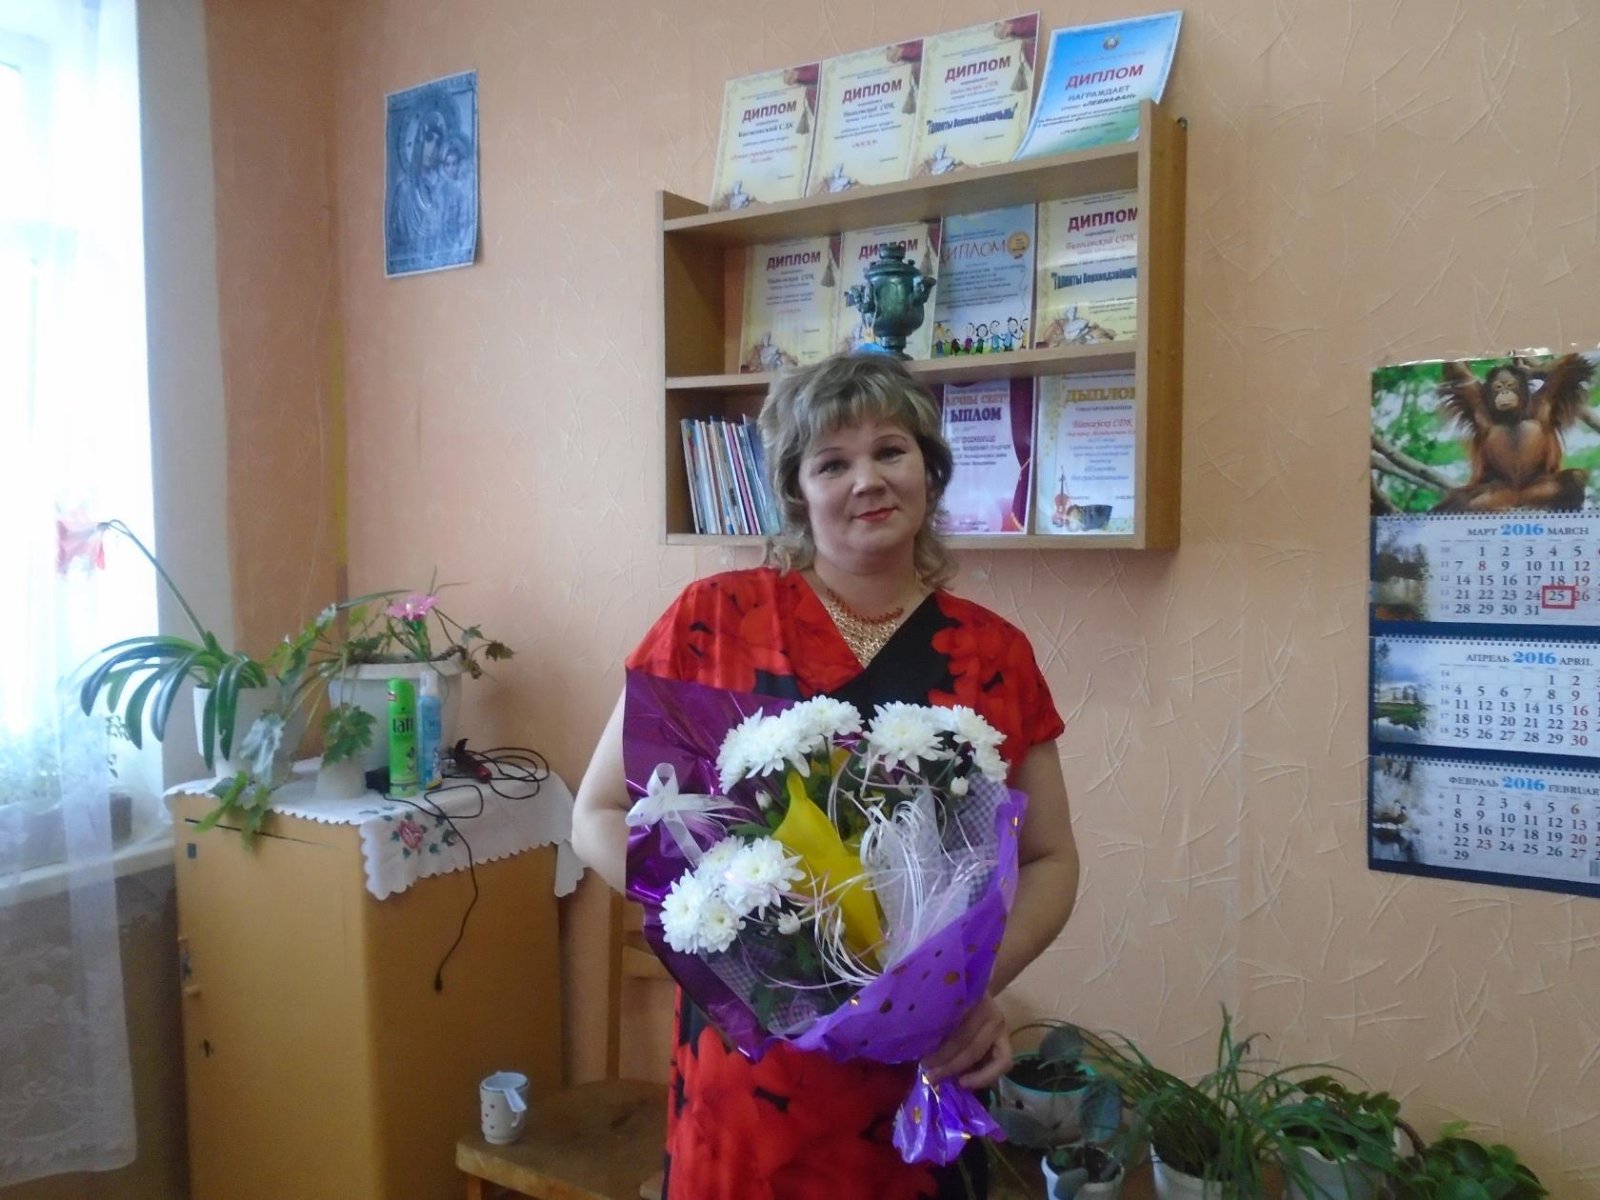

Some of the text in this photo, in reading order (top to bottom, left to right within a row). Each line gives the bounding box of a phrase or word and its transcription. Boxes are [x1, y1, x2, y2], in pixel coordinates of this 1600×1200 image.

[944, 55, 1010, 83] ДИПЛОМ
[1064, 64, 1144, 91] ДИПЛОМ
[842, 79, 902, 104] ДИПЛОМ
[1067, 85, 1130, 102] НАГРАЖДАЕТ
[742, 100, 796, 124] ДИПЛОМ
[1067, 207, 1138, 232] ДИПЛОМ
[858, 238, 918, 260] ДИОМ
[766, 251, 821, 271] ДИПЛОМ
[945, 407, 1002, 423] ЫПЛОМ
[1467, 524, 1589, 536] МАРТ 2016 MARCH
[1479, 546, 1582, 557] 1 2 3 4 5
[1455, 561, 1464, 571] 7
[1478, 561, 1486, 571] 8
[1502, 561, 1509, 571] 9
[1526, 561, 1542, 571] 10
[1550, 561, 1564, 571] 11
[1574, 561, 1590, 572] 12
[1456, 575, 1471, 586] 14
[1479, 575, 1494, 586] 15
[1502, 575, 1517, 586] 16
[1526, 575, 1541, 586] 17
[1550, 575, 1565, 586] 18
[1574, 575, 1590, 586] 19
[1455, 589, 1470, 600] 21
[1478, 590, 1494, 600] 22
[1502, 590, 1517, 600] 23
[1525, 590, 1541, 600] 24
[1548, 590, 1565, 601] 25
[1574, 590, 1590, 601] 26
[1455, 604, 1471, 614] 28
[1478, 604, 1494, 615] 29
[1501, 604, 1517, 615] 30
[1524, 604, 1540, 616] 31
[1466, 651, 1593, 666] АПРЕЛЬ 2016 APRIL
[1548, 674, 1555, 685] 1
[1572, 675, 1580, 686] 2
[1454, 685, 1462, 695] 4
[1477, 686, 1485, 697] 5
[1500, 687, 1509, 698] 6
[1524, 688, 1532, 699] 7
[1548, 689, 1556, 700] 8
[1571, 690, 1580, 701] 9
[1455, 699, 1469, 710] 11
[1478, 700, 1493, 711] 12
[1501, 702, 1516, 712] 13
[1525, 703, 1540, 714] 14
[1549, 704, 1563, 715] 15
[1572, 705, 1589, 716] 16
[1455, 713, 1470, 724] 18
[1478, 714, 1493, 725] 19
[1500, 715, 1516, 727] 20
[1524, 717, 1538, 728] 21
[1547, 718, 1563, 730] 22
[1571, 720, 1588, 731] 23
[1454, 728, 1469, 739] 25
[1477, 729, 1493, 740] 26
[1500, 730, 1515, 741] 27
[1523, 732, 1539, 743] 28
[1547, 733, 1563, 744] 29
[1571, 735, 1588, 747] 30
[1449, 777, 1499, 787] ФЕВРАЛЬ
[1502, 777, 1546, 791] 2016
[1455, 793, 1461, 804] 1
[1478, 795, 1485, 806] 2
[1500, 798, 1508, 809] 3
[1523, 799, 1531, 811] 4
[1548, 802, 1555, 813] 5
[1571, 803, 1579, 815] 6
[1454, 808, 1587, 831] 8 9 10 11 12 13
[1455, 822, 1587, 845] 15 16 17 18 19 20
[1454, 836, 1586, 859] 22 23 24 25 26 27
[1454, 850, 1469, 861] 29
